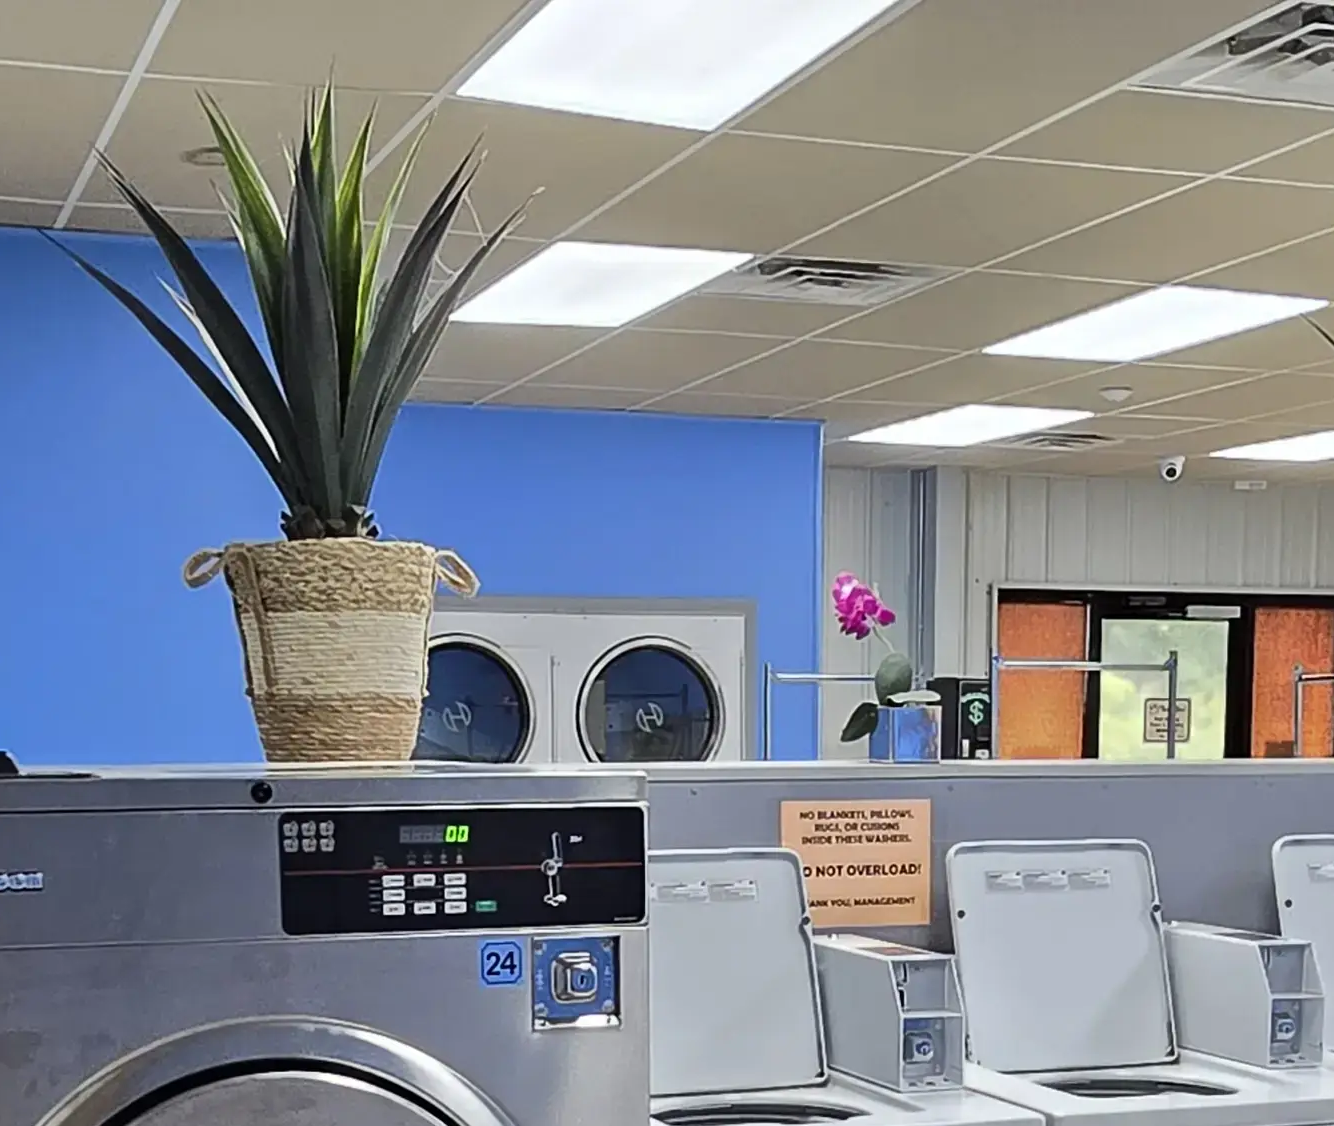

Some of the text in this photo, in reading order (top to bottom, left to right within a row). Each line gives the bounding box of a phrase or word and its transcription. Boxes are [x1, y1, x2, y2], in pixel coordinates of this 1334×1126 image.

[799, 811, 814, 820] NO
[844, 823, 858, 832] OR
[445, 825, 469, 843] 00
[801, 835, 832, 845] INSIDE
[835, 834, 864, 844] THESE
[816, 865, 843, 877] NOT
[846, 864, 922, 877] OVERLOAD!
[809, 899, 828, 908] ANK
[854, 896, 916, 906] MANAGEMENT
[486, 951, 517, 976] 24
